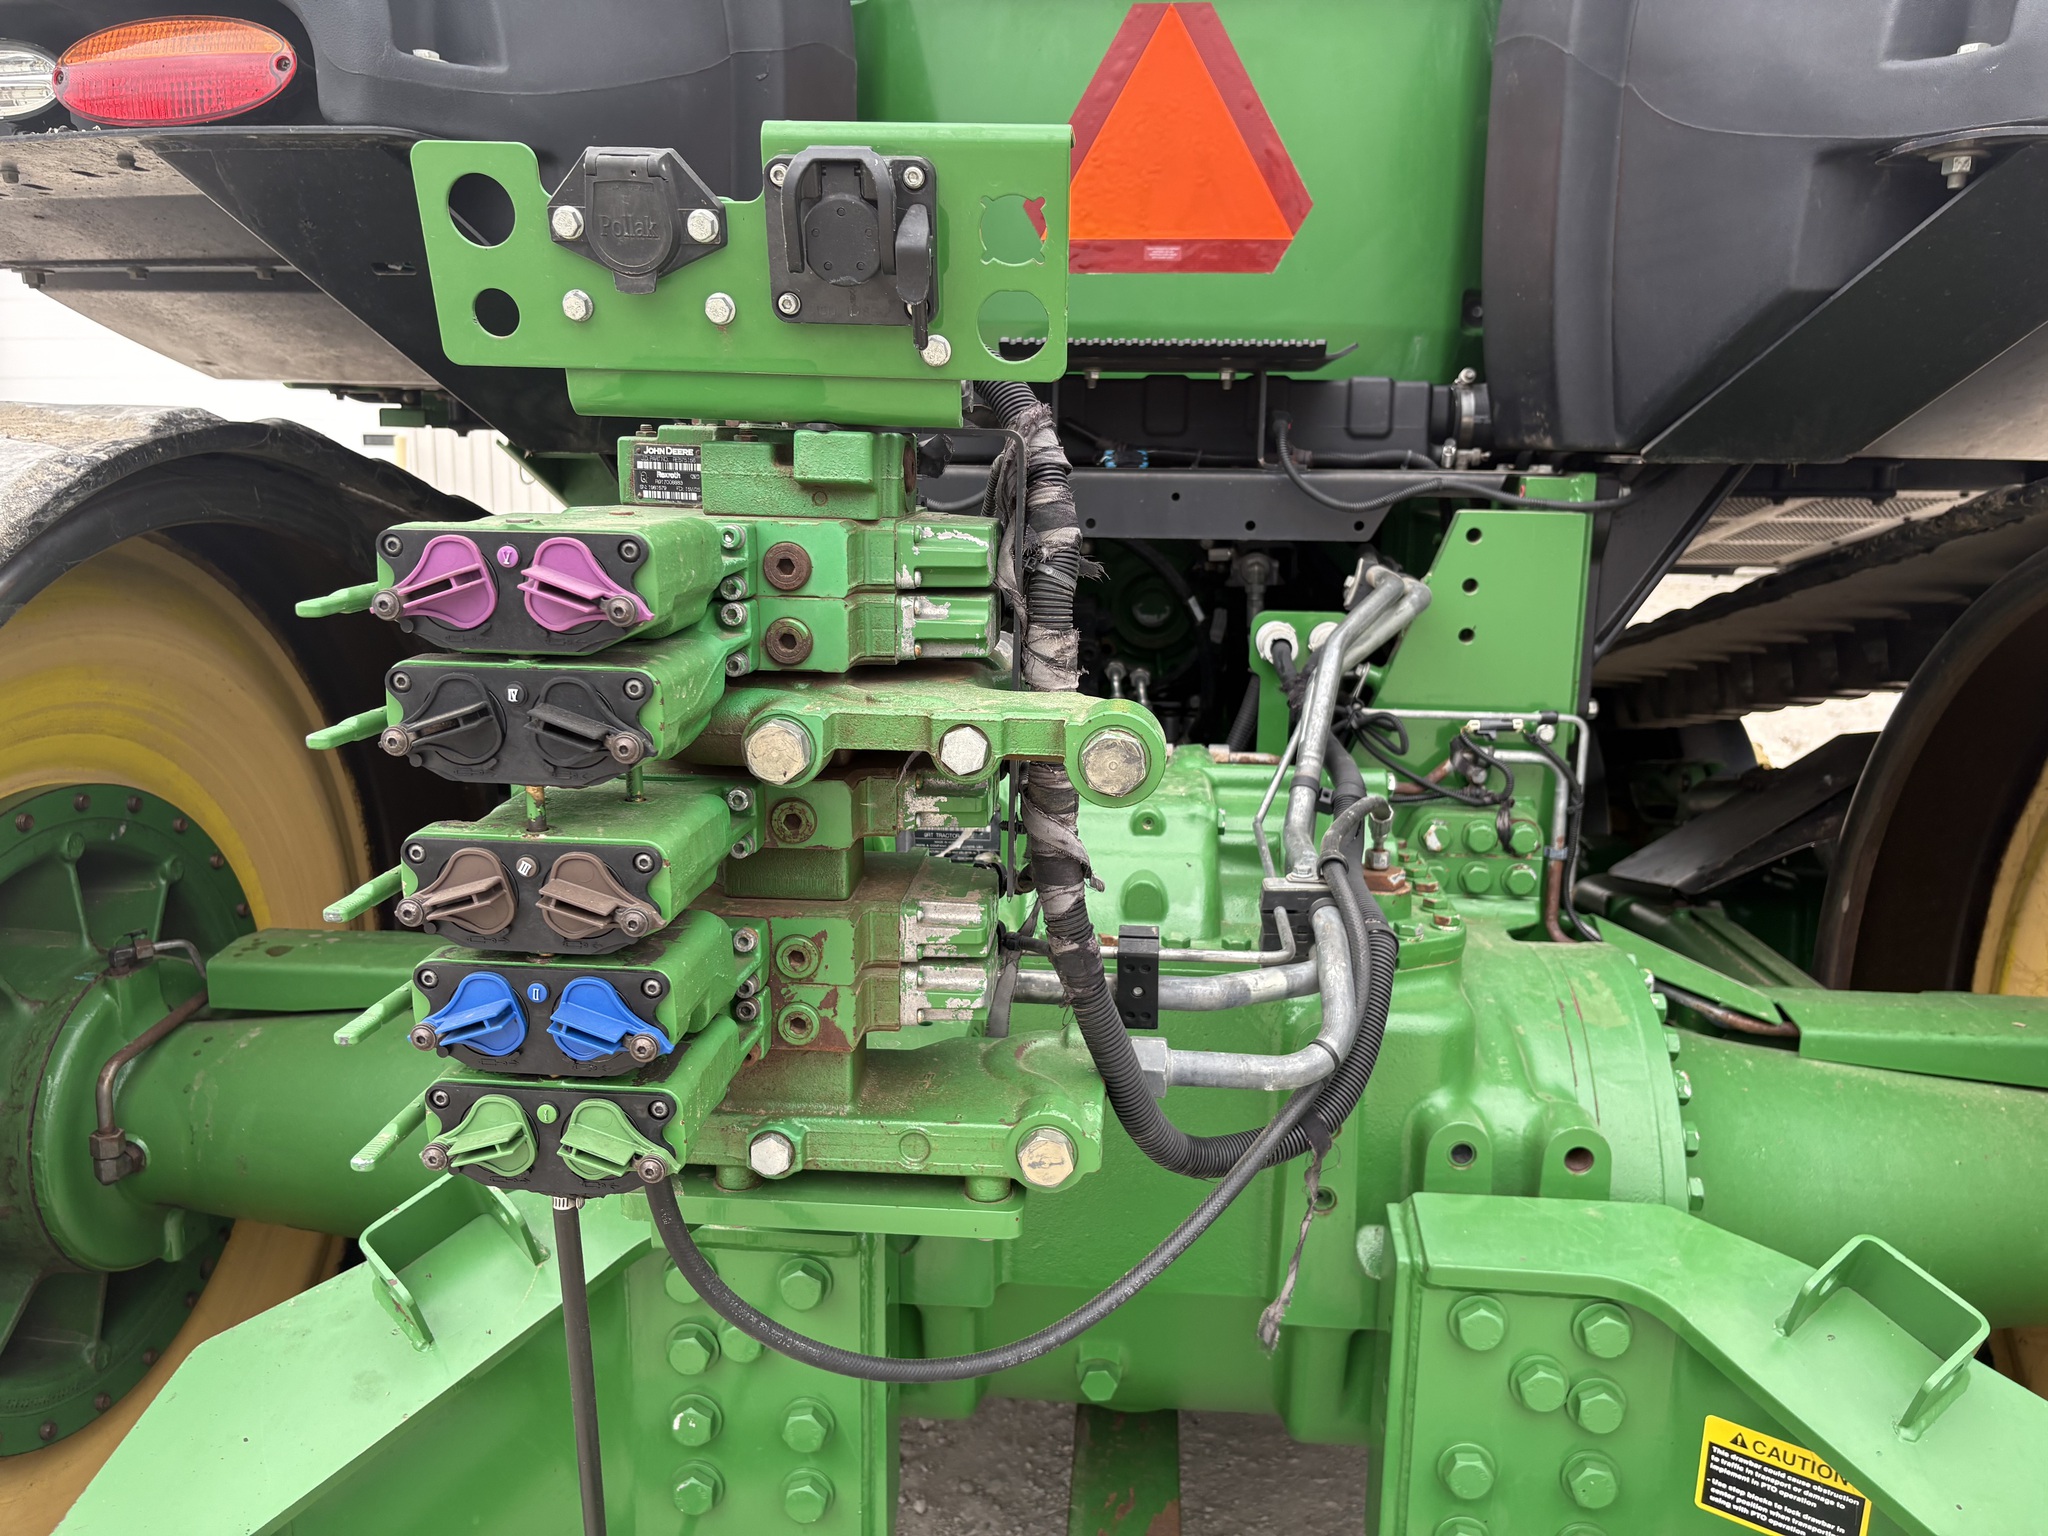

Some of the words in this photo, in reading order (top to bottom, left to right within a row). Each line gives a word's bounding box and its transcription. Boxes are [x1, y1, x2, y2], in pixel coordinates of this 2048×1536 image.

[598, 214, 660, 240] Pollak
[644, 446, 665, 455] JOHN
[666, 447, 694, 456] DEERE
[656, 471, 681, 479] Rexroth
[501, 551, 513, 565] V
[1710, 1463, 1750, 1483] implement
[1751, 1478, 1760, 1487] in
[1761, 1482, 1778, 1493] PTO
[1779, 1490, 1817, 1508] operation
[1712, 1446, 1730, 1458] This
[1730, 1454, 1763, 1470] drawbar
[1763, 1466, 1786, 1479] could
[1787, 1475, 1811, 1488] cause
[1812, 1485, 1859, 1506] obstruction
[1721, 1459, 1744, 1472] traffic
[1745, 1467, 1754, 1476] in
[1755, 1472, 1792, 1490] transport
[1803, 1490, 1835, 1506] damage
[1836, 1502, 1846, 1510] to
[1710, 1487, 1735, 1500] center
[1736, 1497, 1768, 1514] position
[1769, 1510, 1791, 1522] when
[1792, 1518, 1838, 1536] transporti
[1710, 1495, 1732, 1509] using
[1733, 1504, 1749, 1515] with
[1750, 1510, 1767, 1521] PTO
[1768, 1519, 1806, 1536] operation
[1712, 1478, 1727, 1489] Use
[1728, 1485, 1746, 1496] stop
[1747, 1492, 1773, 1507] blocks
[1774, 1502, 1783, 1510] to
[1784, 1506, 1801, 1518] lock
[1802, 1514, 1835, 1530] drawbar
[1837, 1526, 1846, 1534] in
